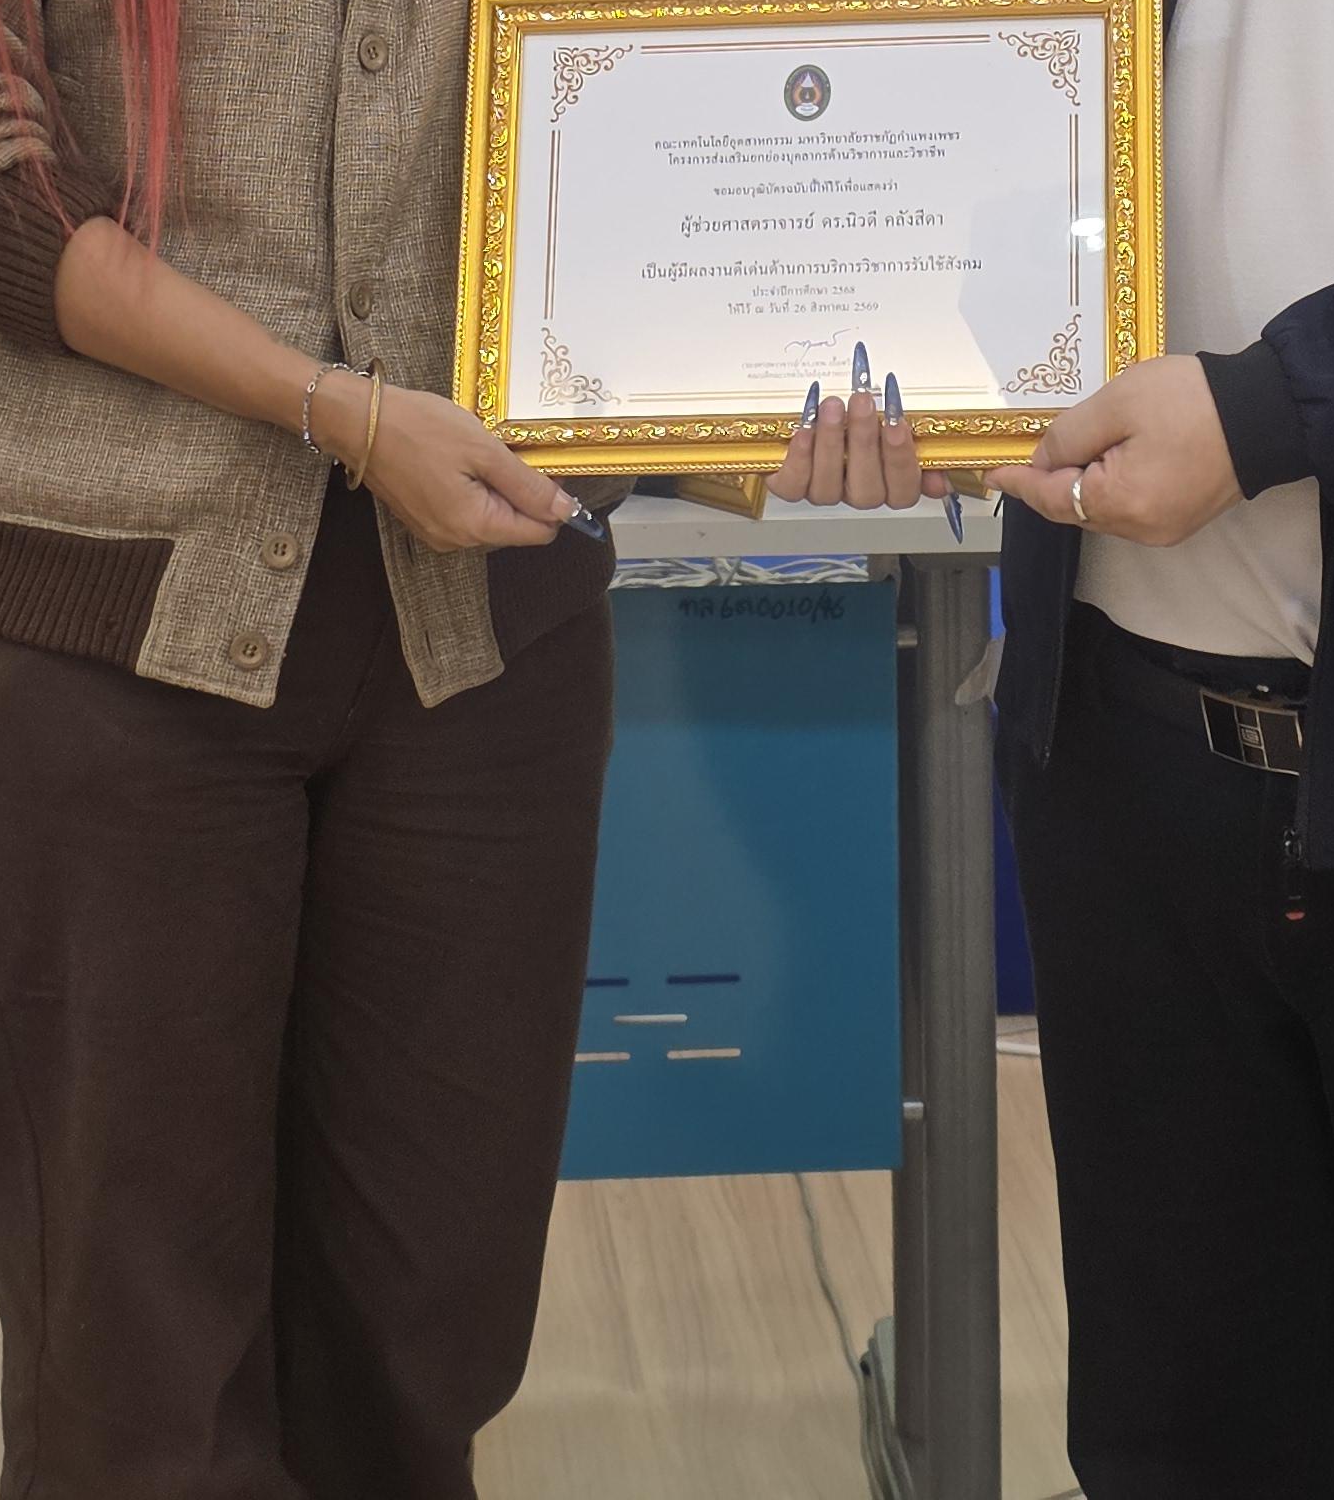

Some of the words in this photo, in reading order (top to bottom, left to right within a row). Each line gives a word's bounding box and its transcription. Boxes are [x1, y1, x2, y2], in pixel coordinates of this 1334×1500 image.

[680, 211, 815, 237] ผู้ช่วยศาสตราจารย์
[884, 208, 945, 228] คลังสีดา
